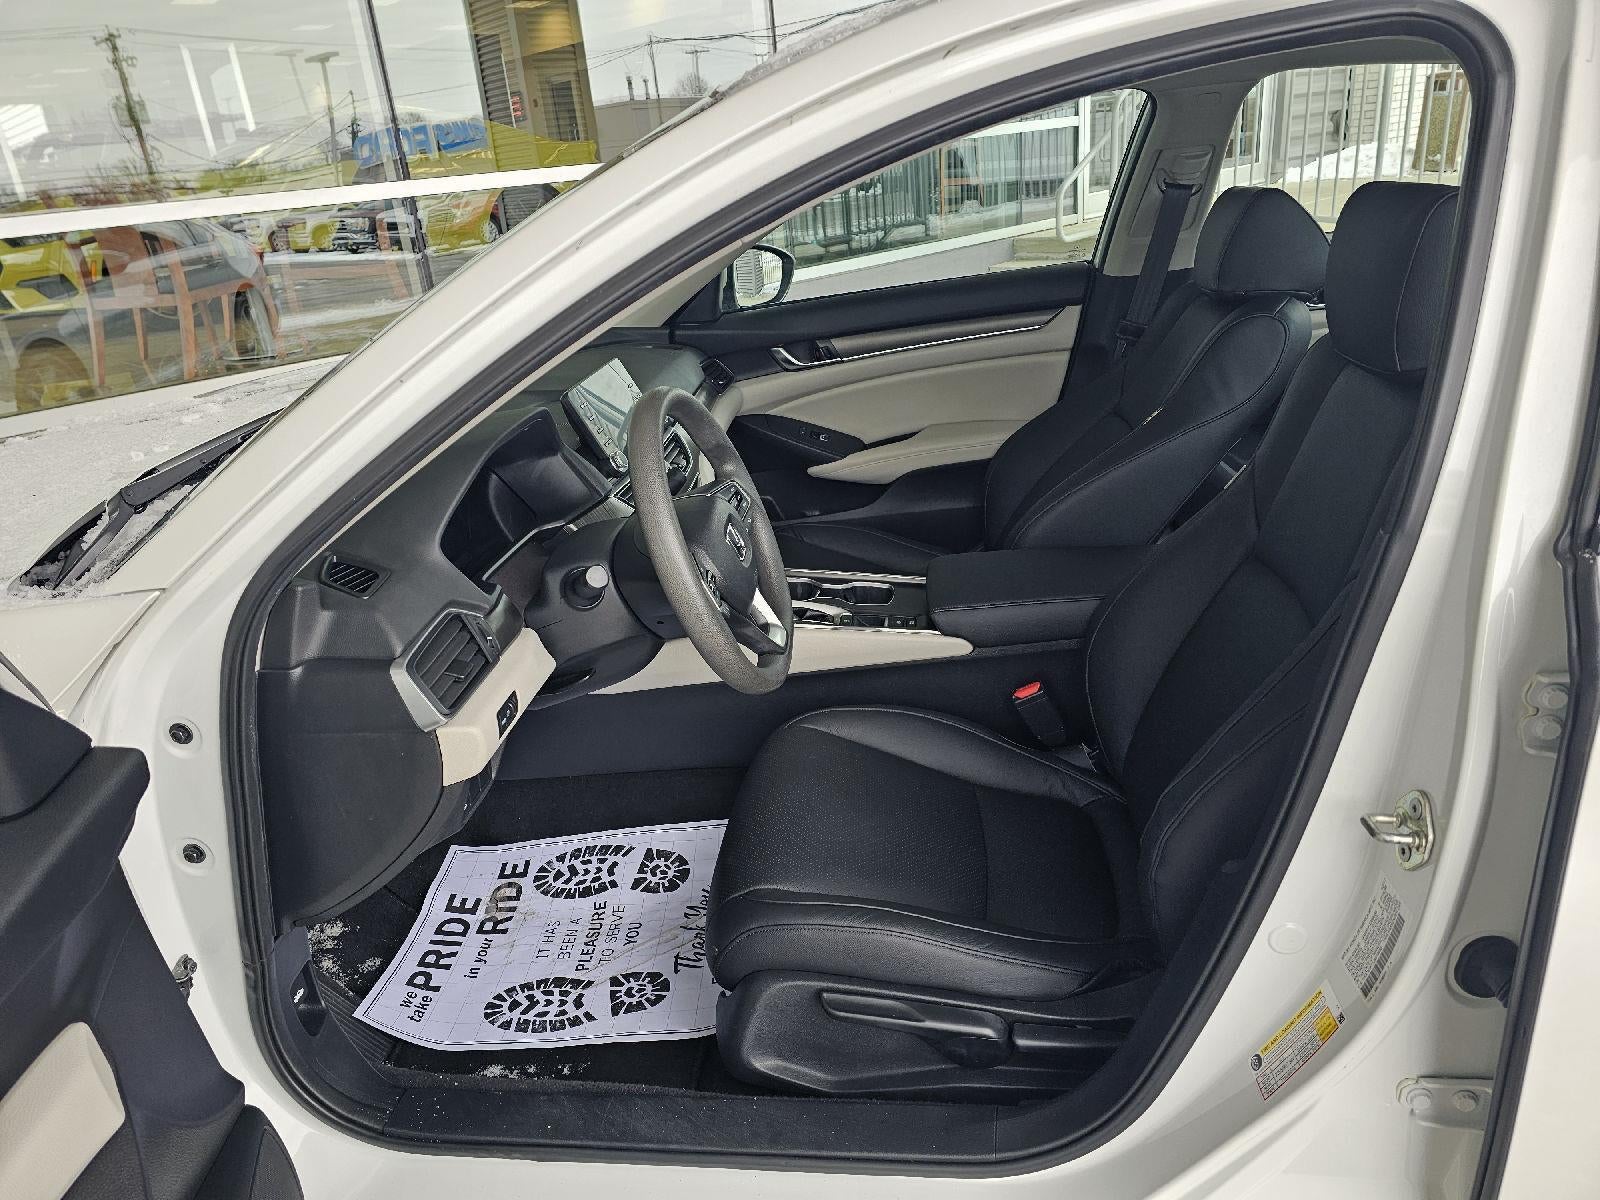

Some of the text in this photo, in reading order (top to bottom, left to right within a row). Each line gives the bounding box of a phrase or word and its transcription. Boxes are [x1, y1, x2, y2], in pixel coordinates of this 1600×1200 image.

[464, 859, 531, 979] in your RIDE
[536, 920, 561, 959] IT HAS
[557, 917, 583, 960] BEEN A
[575, 900, 608, 972] PLEASURE
[598, 905, 626, 964] TO SERVE
[623, 922, 643, 946] YOU
[405, 893, 483, 992] PRIDE
[673, 924, 707, 974] Thank
[400, 991, 418, 1008] we
[407, 995, 432, 1023] take
